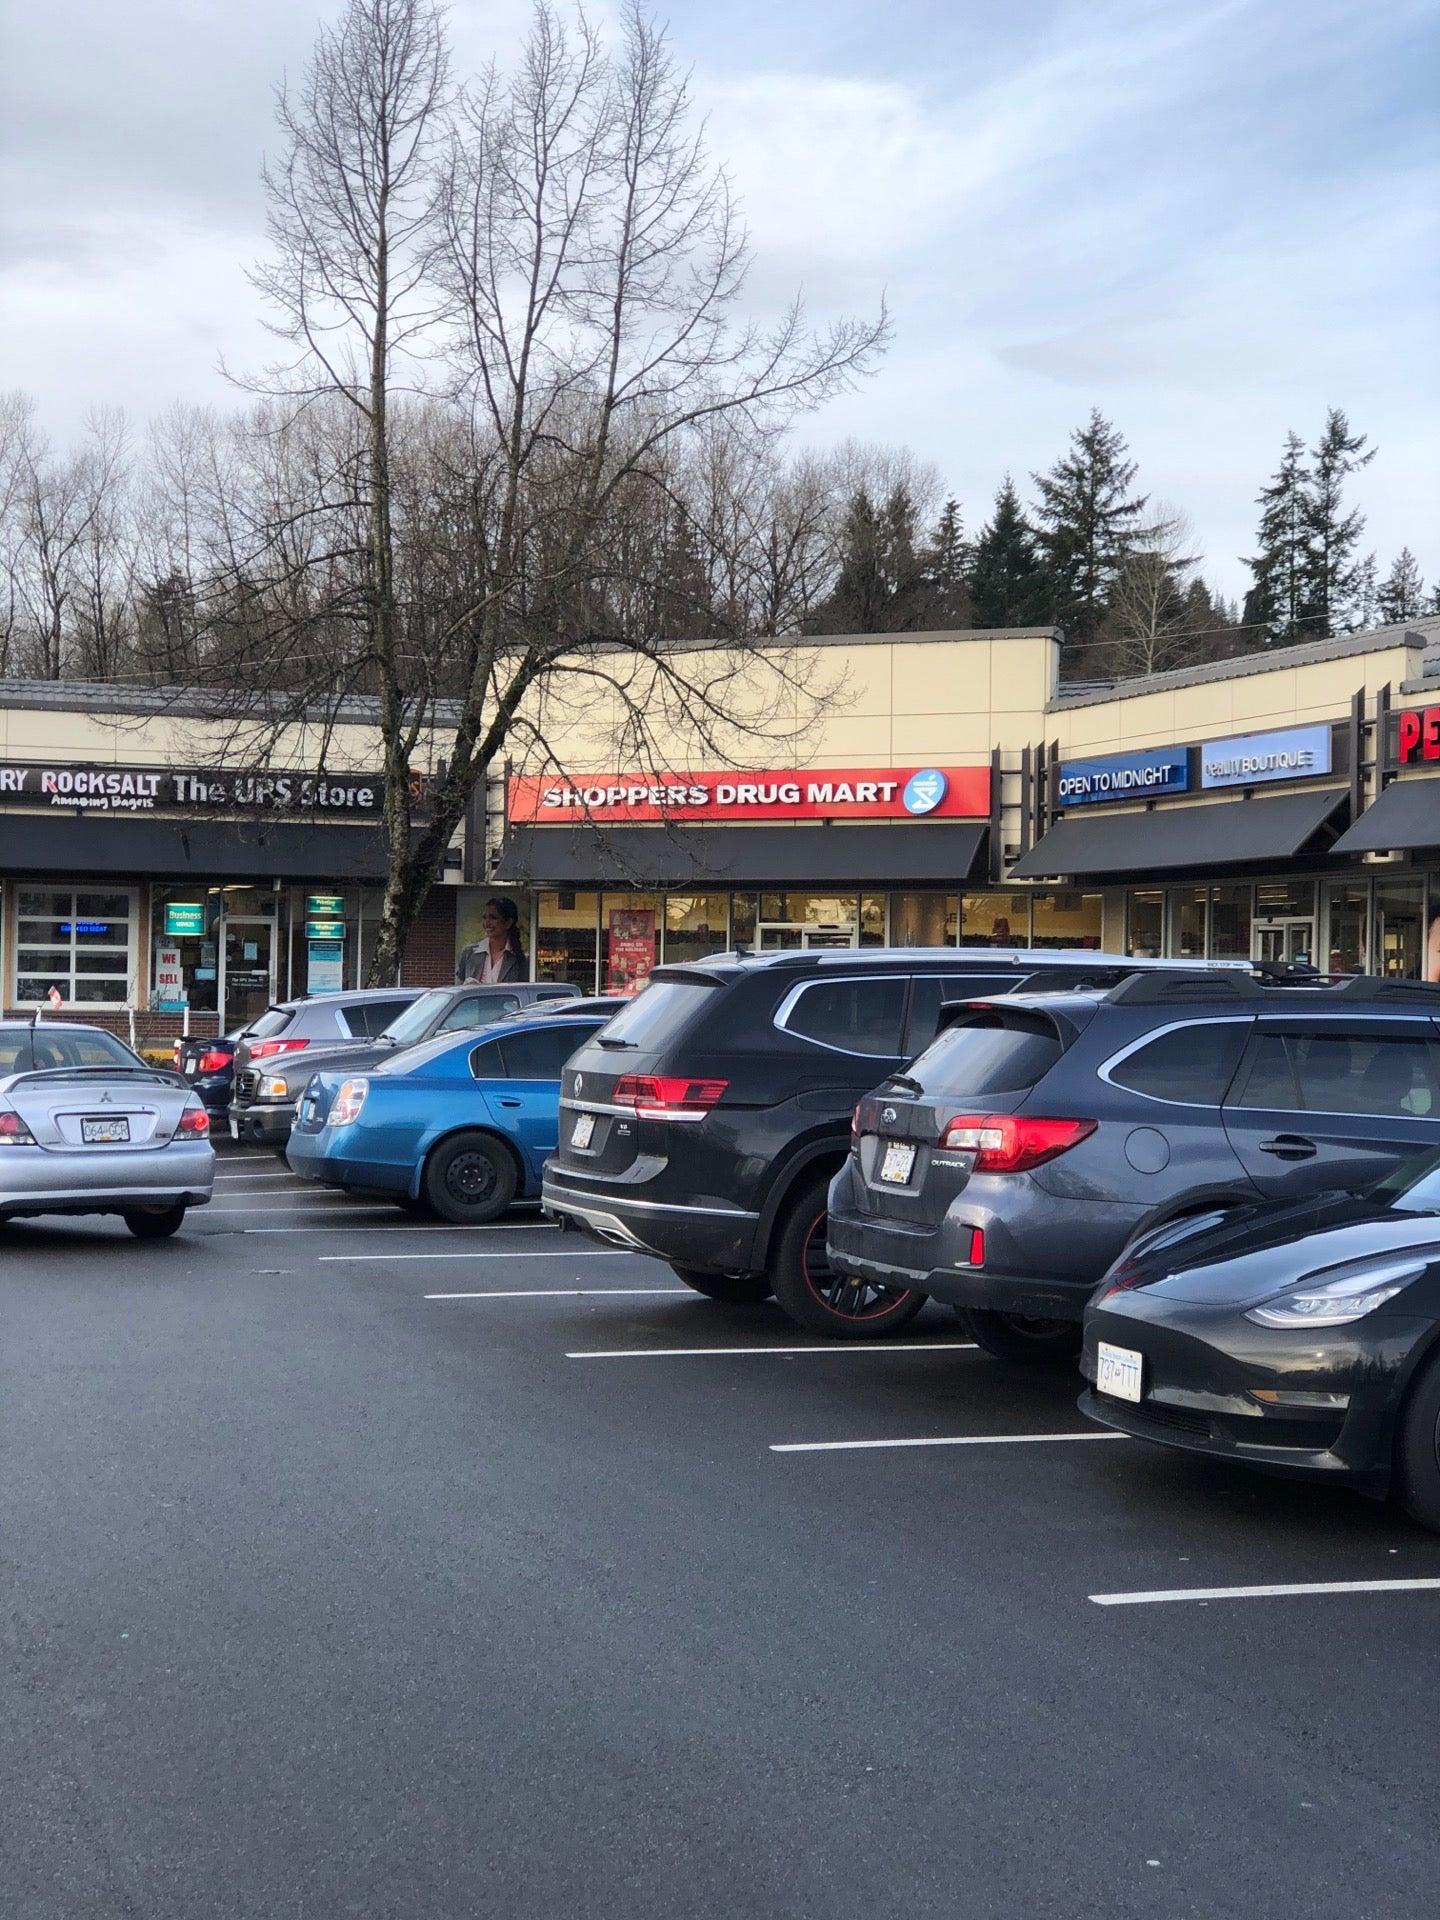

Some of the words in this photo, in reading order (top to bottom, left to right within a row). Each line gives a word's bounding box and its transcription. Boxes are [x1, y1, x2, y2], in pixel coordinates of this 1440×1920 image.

[1242, 750, 1308, 773] BOUTIQUE
[41, 771, 160, 796] ROCKSALT
[173, 775, 225, 802] The
[234, 777, 292, 804] UPS
[301, 778, 374, 807] Store
[1059, 776, 1091, 795] OPEN
[1092, 773, 1110, 791] TO
[1111, 765, 1171, 789] MIDNIGHT
[51, 795, 108, 809] Amazing
[111, 796, 154, 810] Bagels
[543, 784, 708, 807] SHOPPERS
[716, 783, 800, 804] DRUG
[807, 781, 898, 803] MART
[169, 911, 202, 919] Business
[162, 953, 176, 964] WE
[159, 974, 178, 984] SELL
[1100, 1356, 1115, 1383] 737
[1121, 1363, 1139, 1389] TTT
